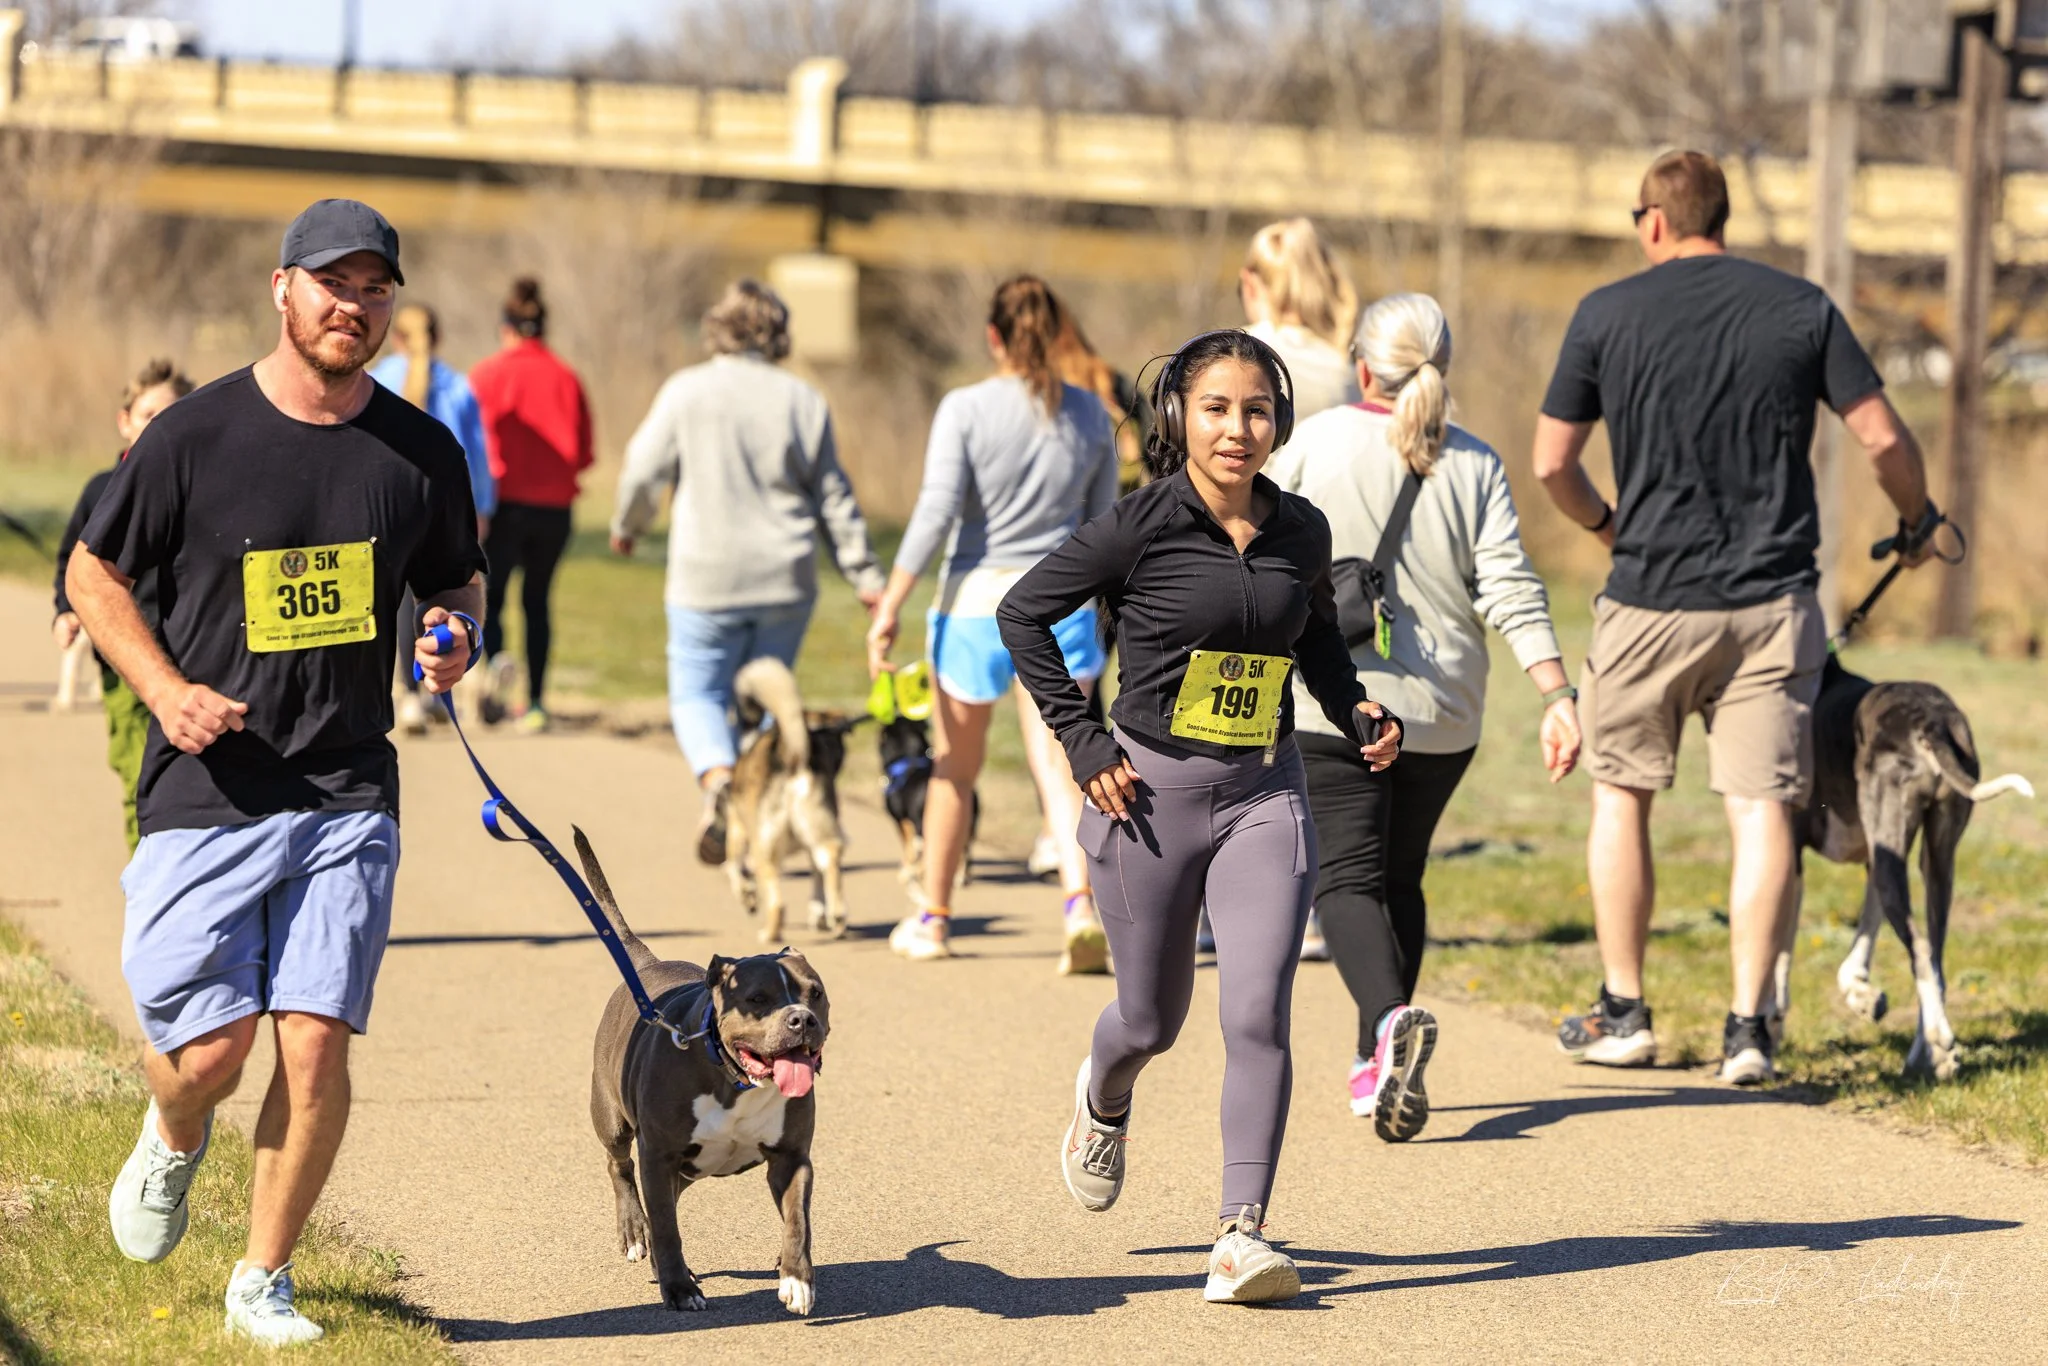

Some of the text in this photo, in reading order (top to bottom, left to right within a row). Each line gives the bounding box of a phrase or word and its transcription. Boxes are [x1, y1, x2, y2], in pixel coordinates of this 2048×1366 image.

[314, 550, 340, 571] 5K
[277, 580, 341, 620] 365
[1248, 659, 1268, 678] 5K
[1211, 684, 1259, 720] 199
[1186, 723, 1200, 731] Good
